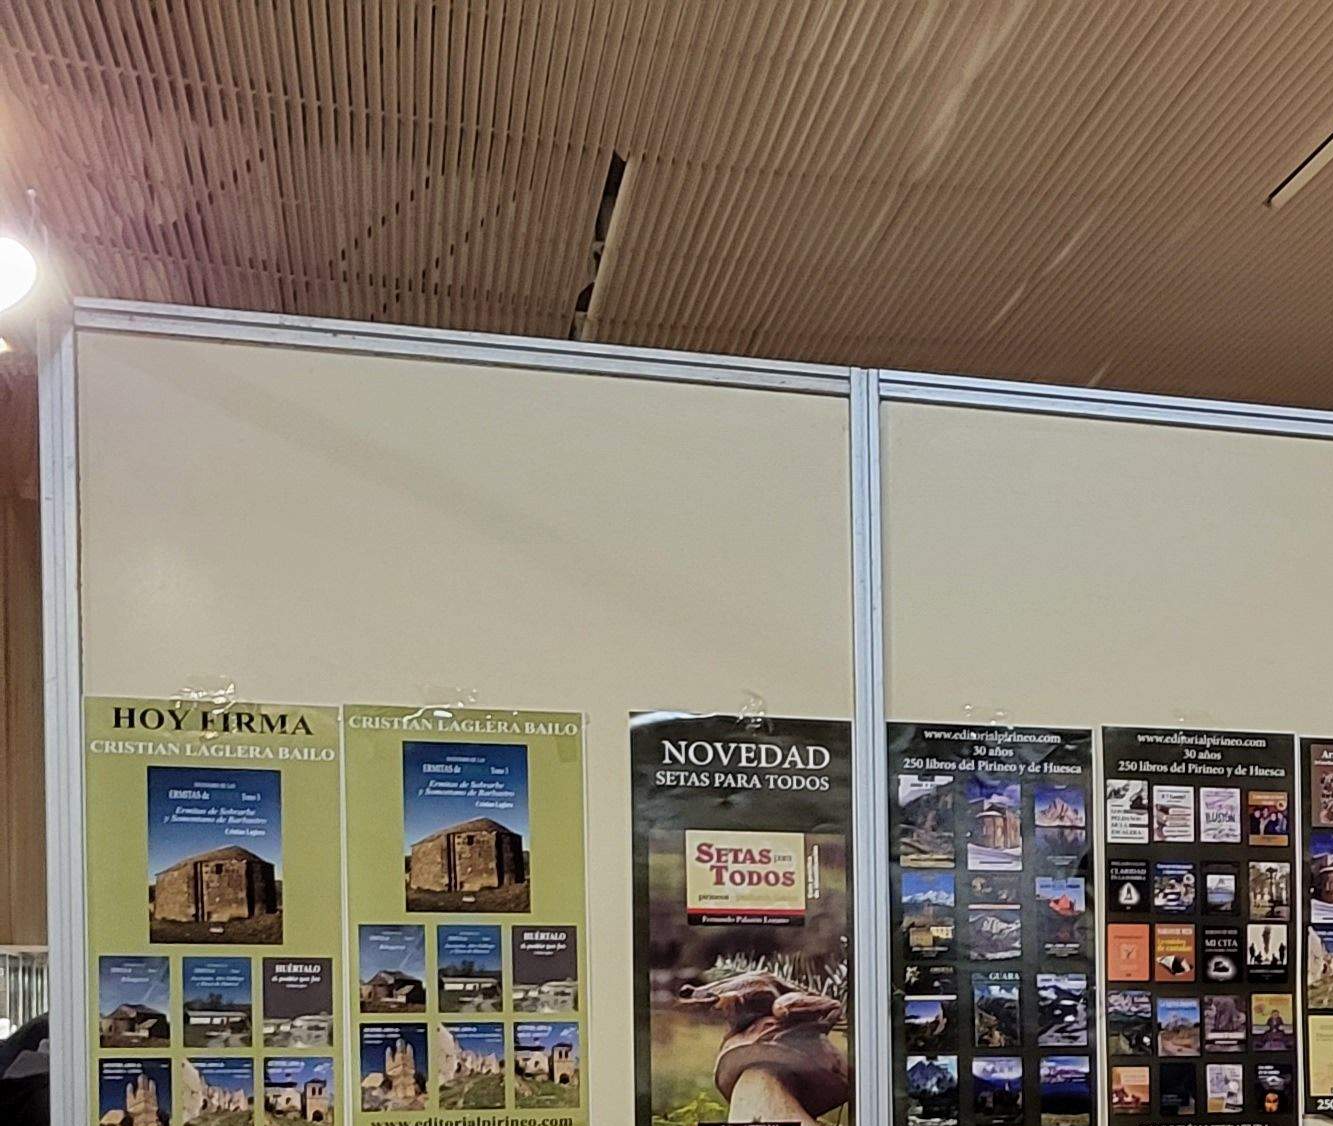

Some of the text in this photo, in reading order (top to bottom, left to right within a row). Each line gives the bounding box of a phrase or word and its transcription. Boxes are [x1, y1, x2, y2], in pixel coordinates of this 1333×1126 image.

[112, 706, 314, 736] HOY FIRMA
[348, 714, 579, 737] CRISTIAN LAGLERA BAILO
[90, 739, 336, 762] CRISTIAN LAGLERA BAILO
[661, 739, 831, 770] NOVEDAD
[973, 745, 1014, 758] 30 años
[903, 758, 924, 769] 250
[925, 758, 956, 770] libros
[958, 759, 975, 771] del
[978, 760, 1017, 772] Pirineo
[1027, 762, 1041, 773] de
[1043, 763, 1082, 774] Huesca
[655, 771, 830, 791] SETAS PARA TODOS
[695, 842, 772, 865] SETAS
[709, 865, 796, 887] TODOS
